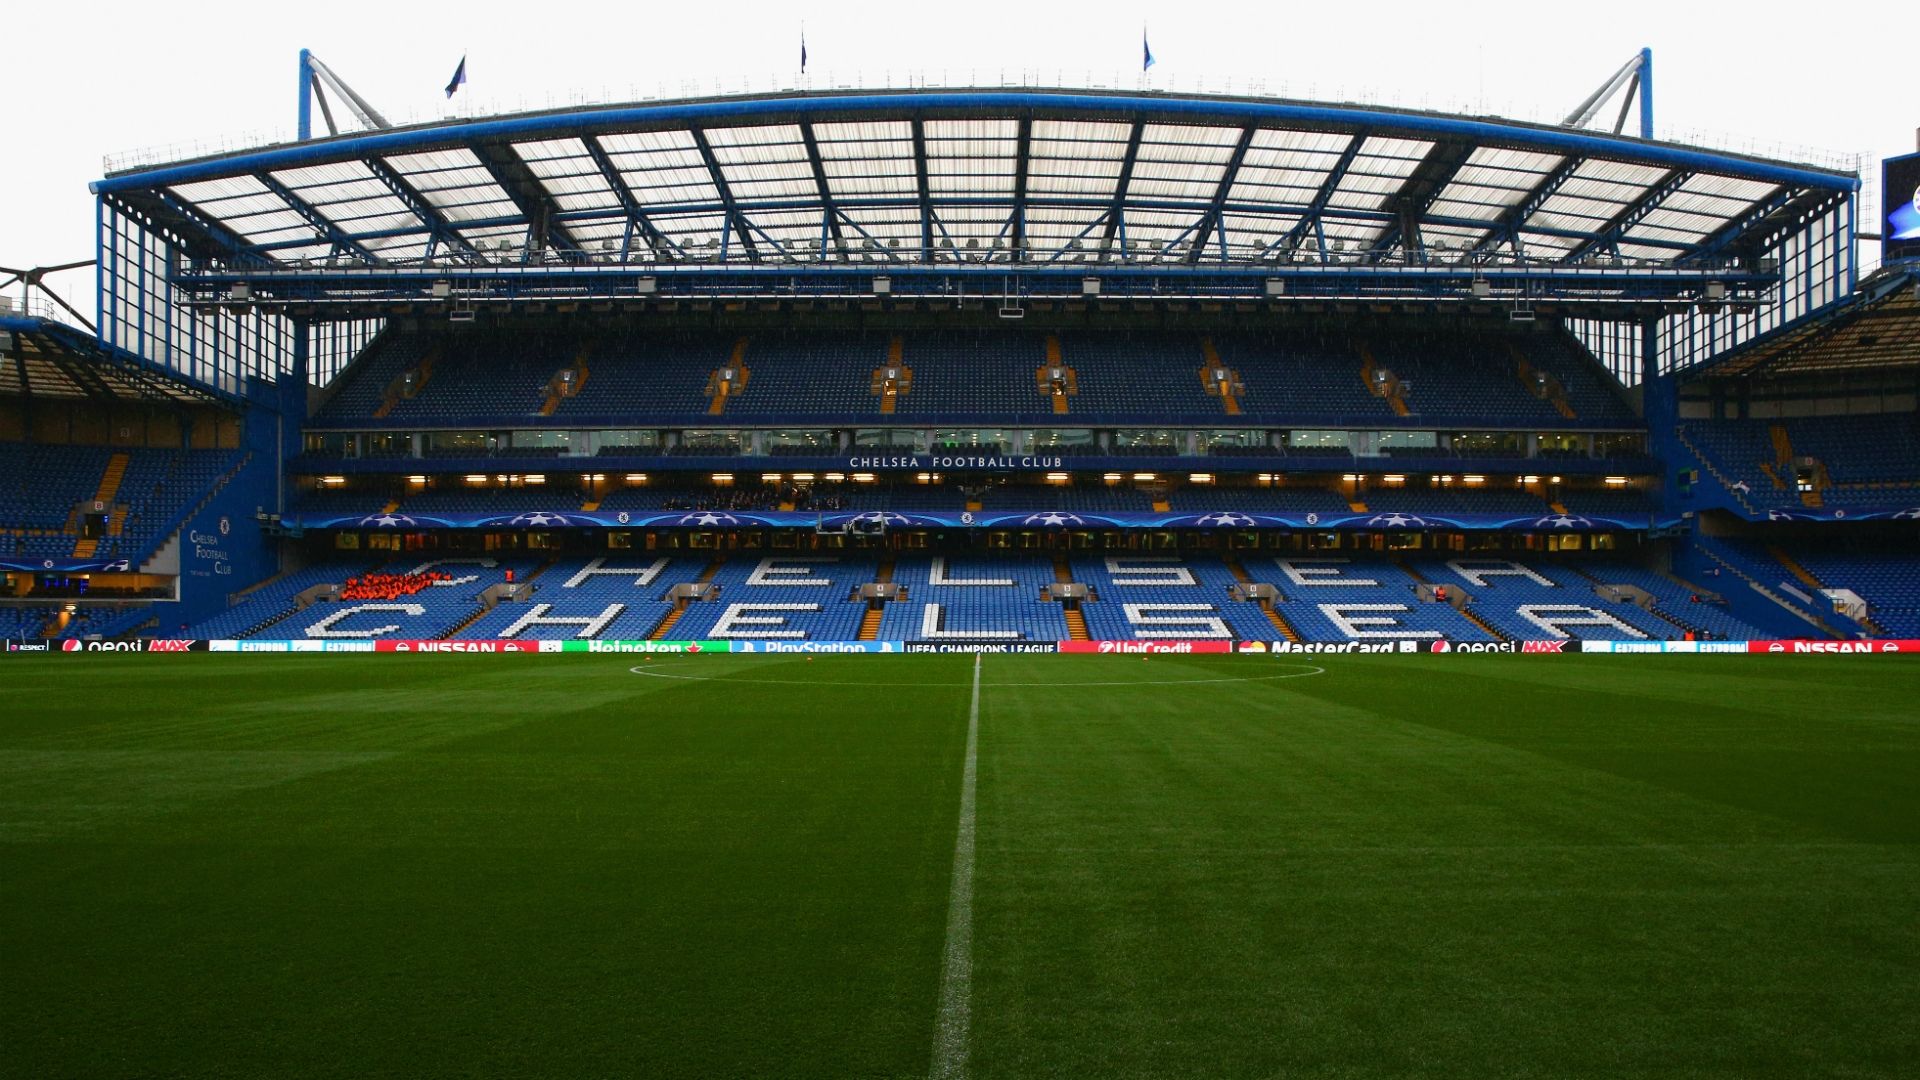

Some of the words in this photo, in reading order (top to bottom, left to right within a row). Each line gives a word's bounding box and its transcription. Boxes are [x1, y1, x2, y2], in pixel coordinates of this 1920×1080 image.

[850, 457, 919, 467] CHELSEA
[933, 457, 1015, 467] FOOTBALL
[1022, 457, 1062, 467] CLUB
[214, 561, 232, 575] CLUB
[305, 603, 1649, 639] CHELSEA
[418, 643, 496, 652] NISSAN
[940, 644, 1007, 652] CHAMPIONS
[1793, 642, 1872, 652] NISSAN
